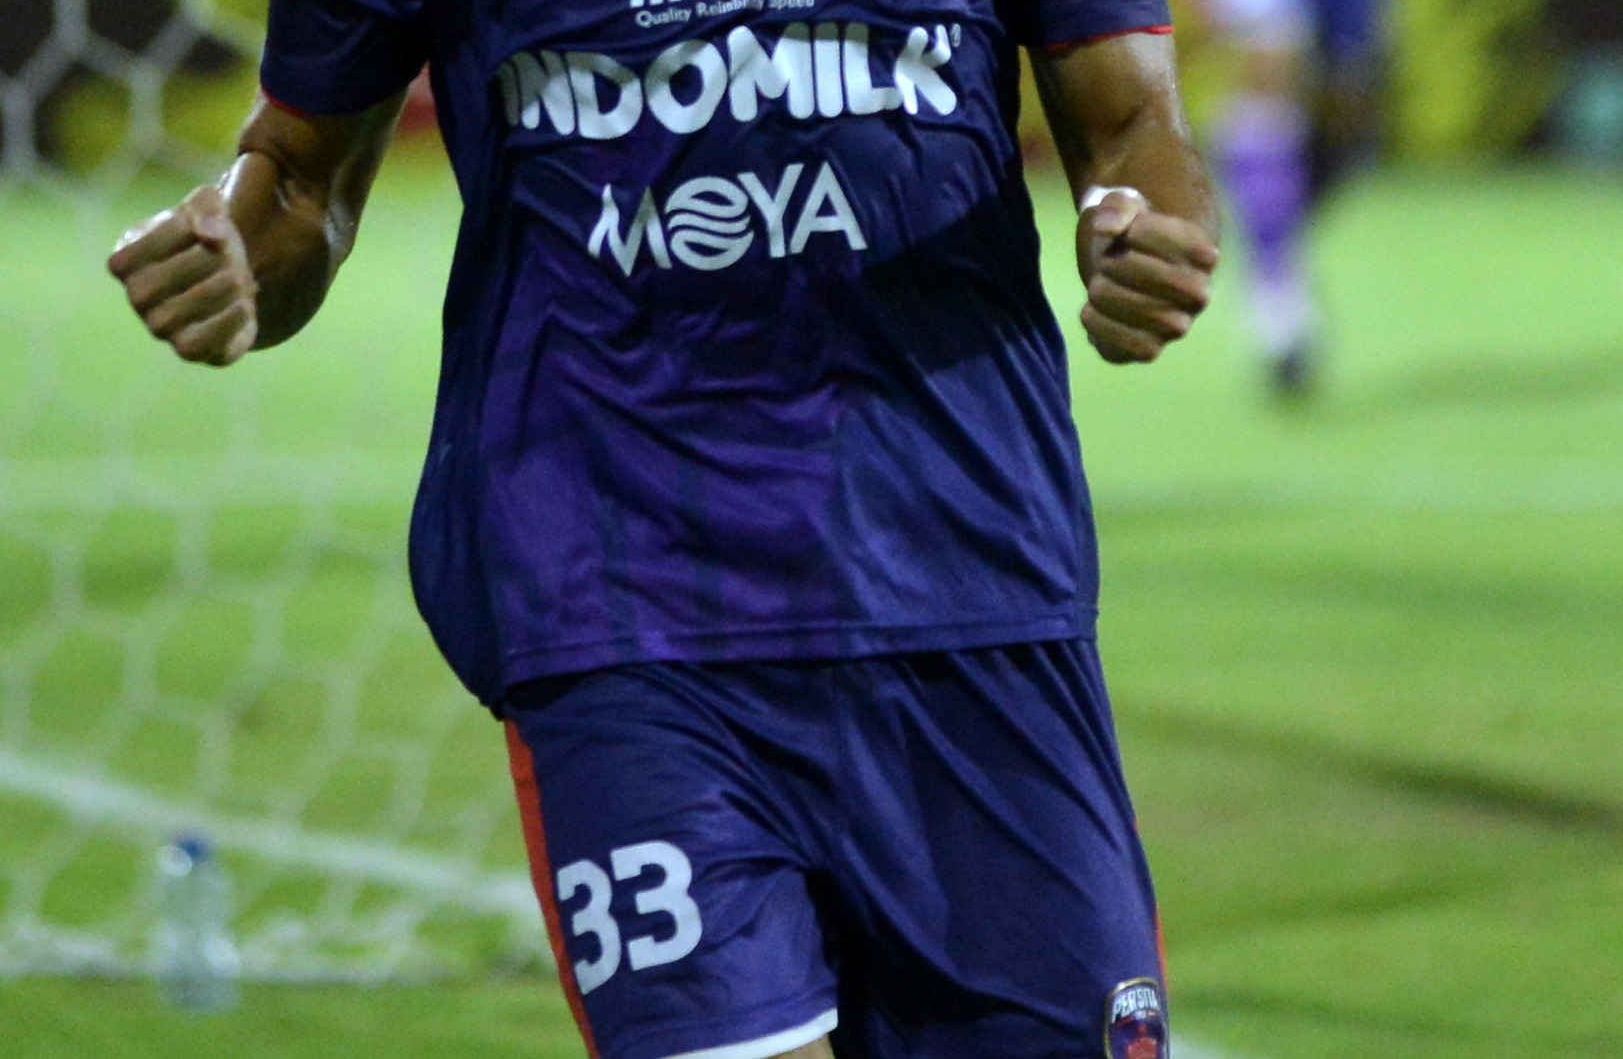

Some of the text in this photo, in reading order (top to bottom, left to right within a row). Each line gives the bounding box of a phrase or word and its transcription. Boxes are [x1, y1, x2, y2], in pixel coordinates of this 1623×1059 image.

[634, 8, 692, 28] Quality
[498, 22, 958, 140] INDOMILK
[587, 160, 869, 278] MOYA
[556, 839, 704, 996] 33
